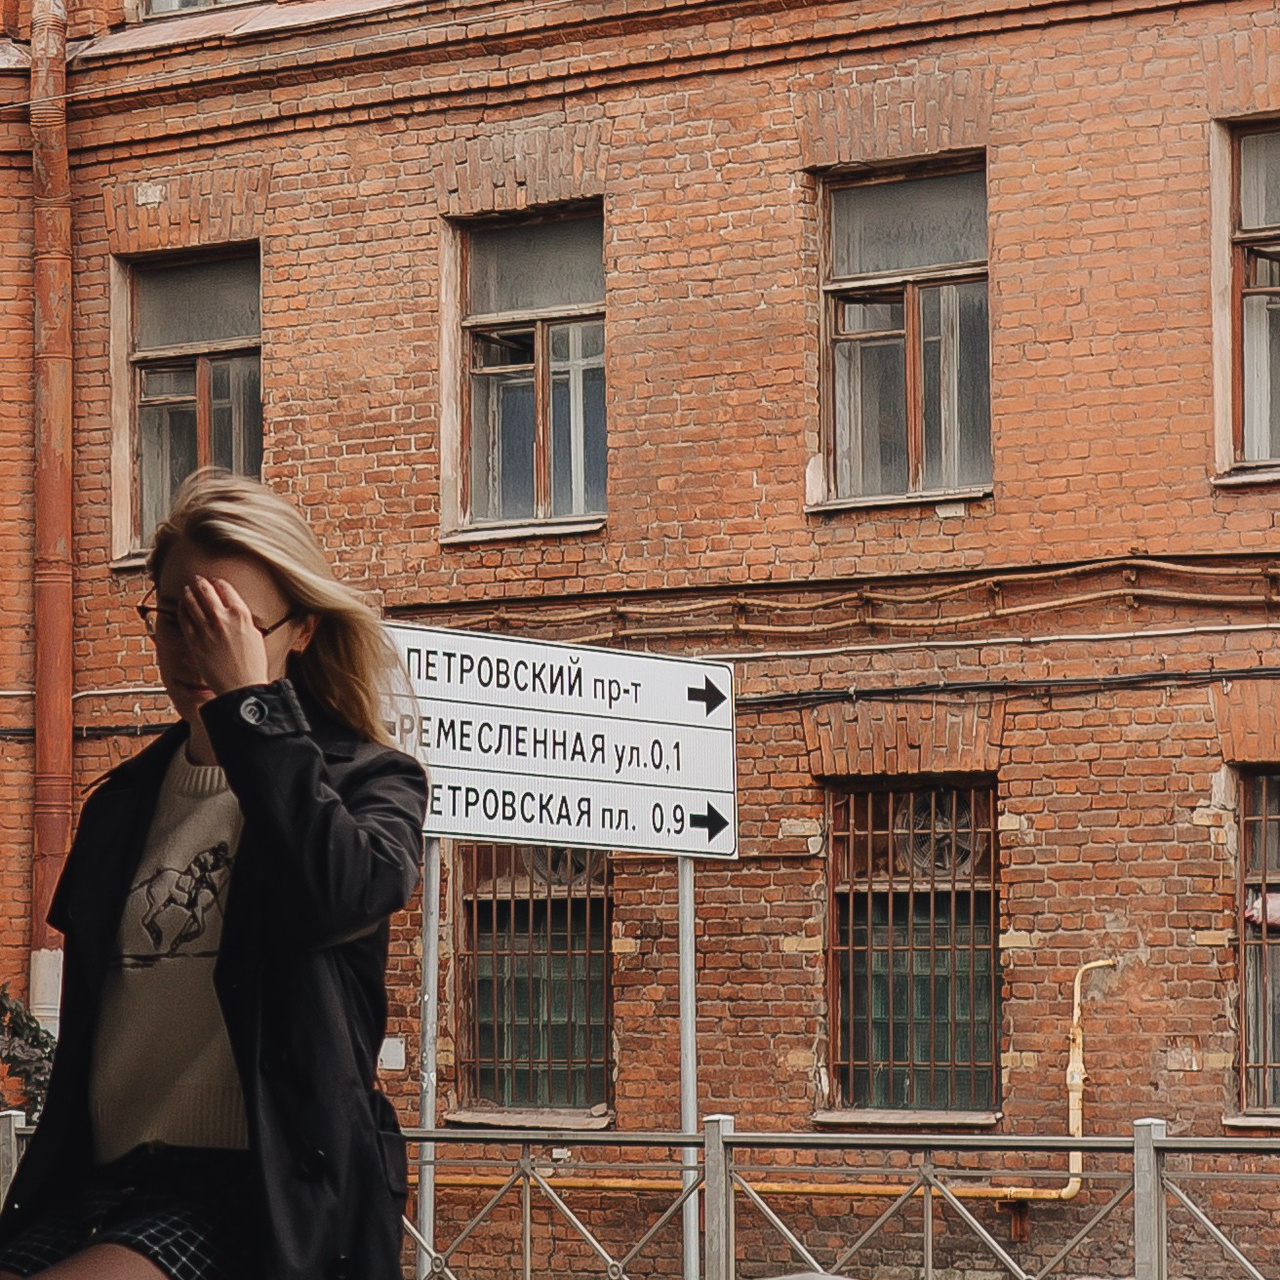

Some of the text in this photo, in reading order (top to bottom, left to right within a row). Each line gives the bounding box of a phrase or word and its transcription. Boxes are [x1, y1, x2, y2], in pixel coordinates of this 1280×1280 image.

[406, 647, 642, 710] ПЕТРОВСКИЙ пр-т
[399, 714, 606, 765] РЕМЕСЛЕННАЯ
[429, 783, 685, 837] ЕТРОВСКАЯ пл. 0,9
